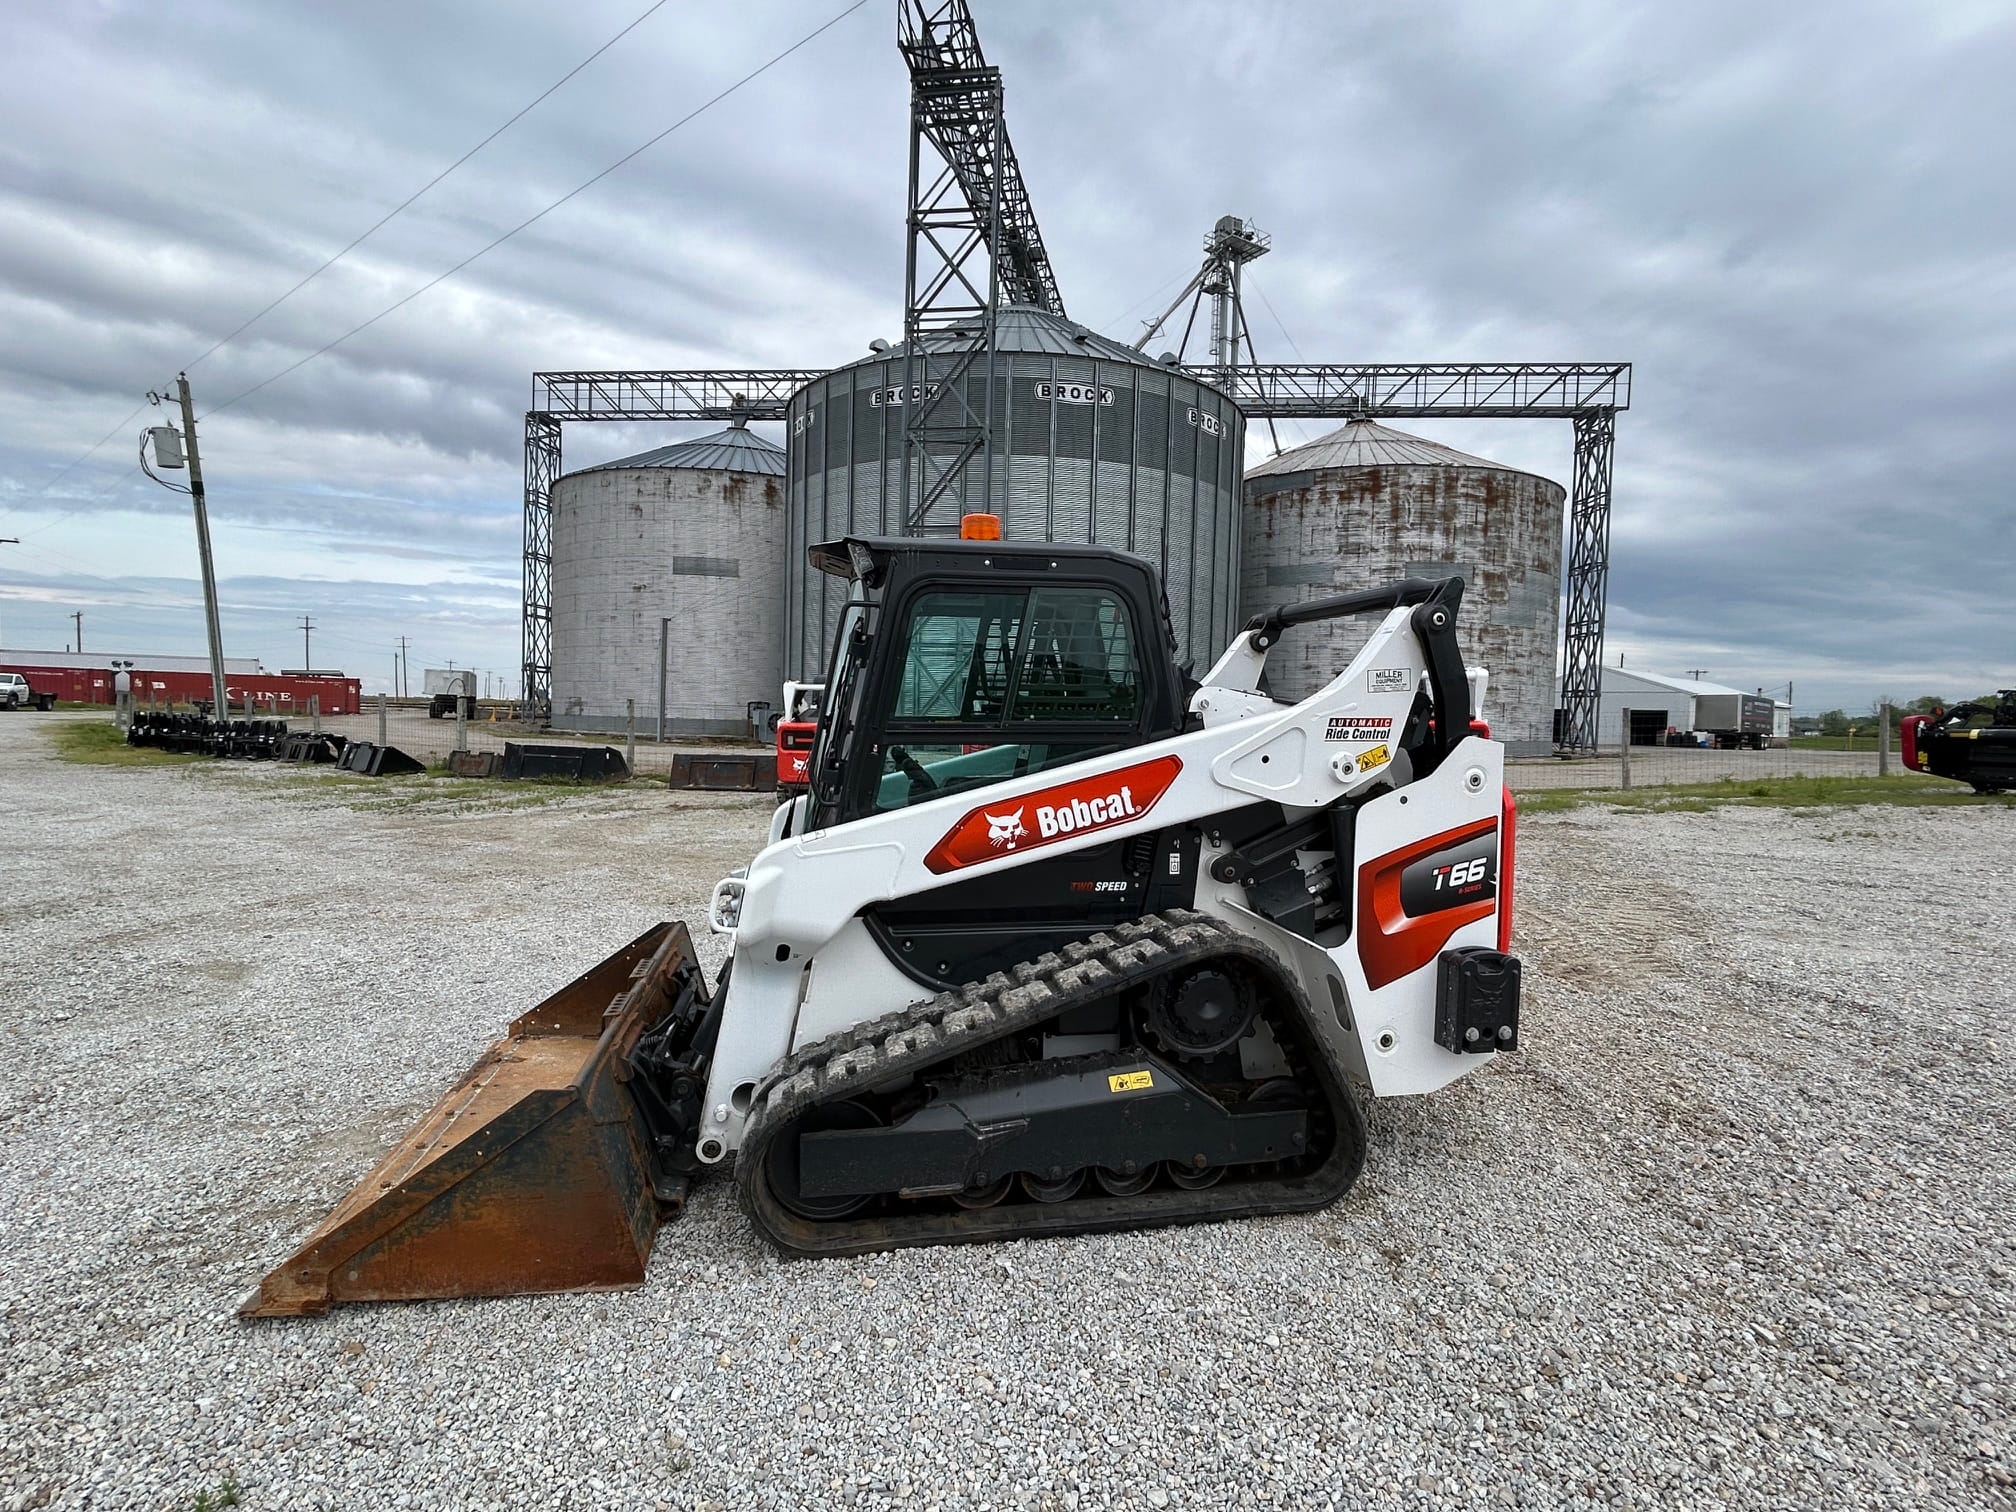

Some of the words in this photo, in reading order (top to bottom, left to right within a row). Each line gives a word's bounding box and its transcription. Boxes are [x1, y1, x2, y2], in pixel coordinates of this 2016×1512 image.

[1041, 385, 1108, 402] BROCK
[1190, 411, 1224, 434] BROC
[1375, 670, 1402, 679] MILLER
[1330, 719, 1391, 727] AUTOMATIC
[1325, 728, 1350, 739] Ride
[1352, 728, 1391, 739] Control
[1036, 786, 1135, 838] Bobcat
[1432, 857, 1488, 891] T66
[1071, 882, 1094, 890] TWO
[1094, 881, 1128, 891] SPEED
